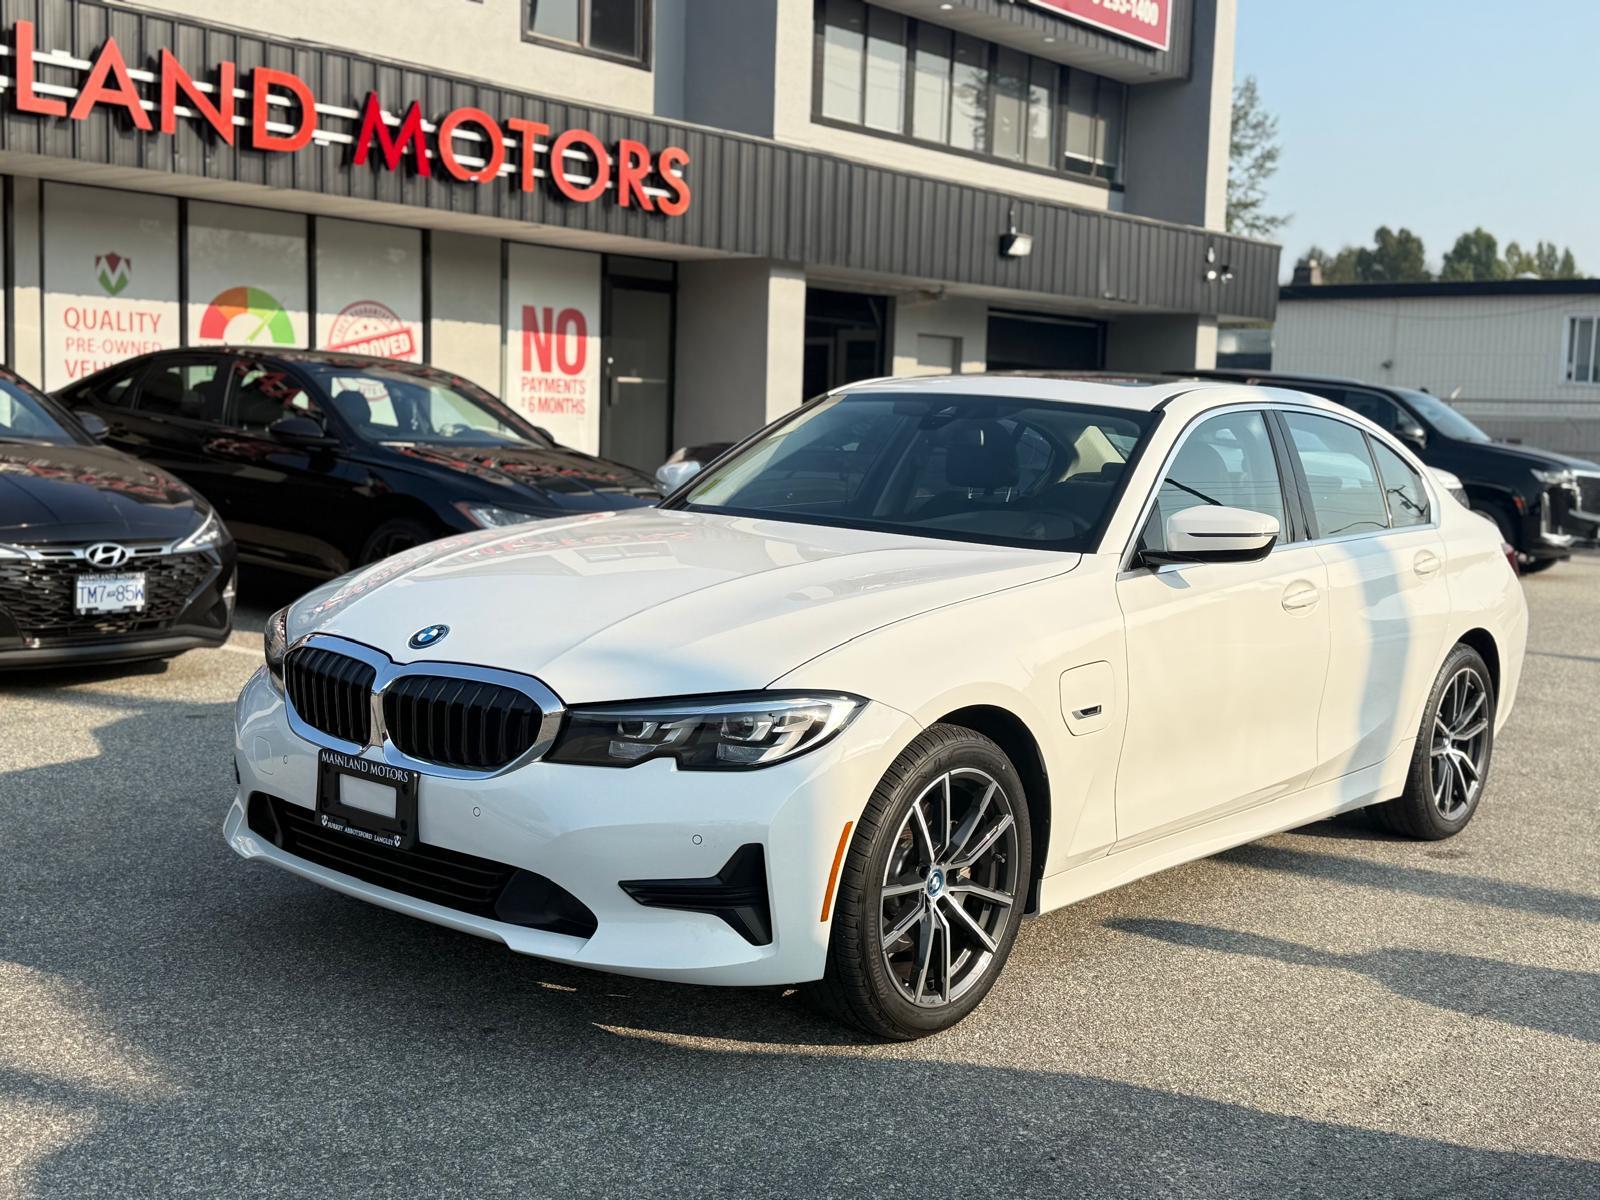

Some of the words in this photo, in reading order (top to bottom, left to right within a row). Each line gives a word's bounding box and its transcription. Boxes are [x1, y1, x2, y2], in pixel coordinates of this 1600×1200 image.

[15, 20, 317, 153] LAND
[353, 90, 692, 217] MOTORS
[64, 306, 161, 334] QUALITY
[65, 337, 163, 355] PRE-OWNED
[340, 332, 411, 357] PROVED
[521, 305, 588, 376] NO
[521, 376, 586, 396] PAYMENTS
[528, 396, 536, 414] 6
[537, 397, 586, 416] MONTHS
[321, 751, 369, 773] MAINLAND
[370, 764, 409, 783] MOTORS
[344, 826, 373, 840] ABBOTSFORD
[373, 834, 394, 847] LANGLEY
